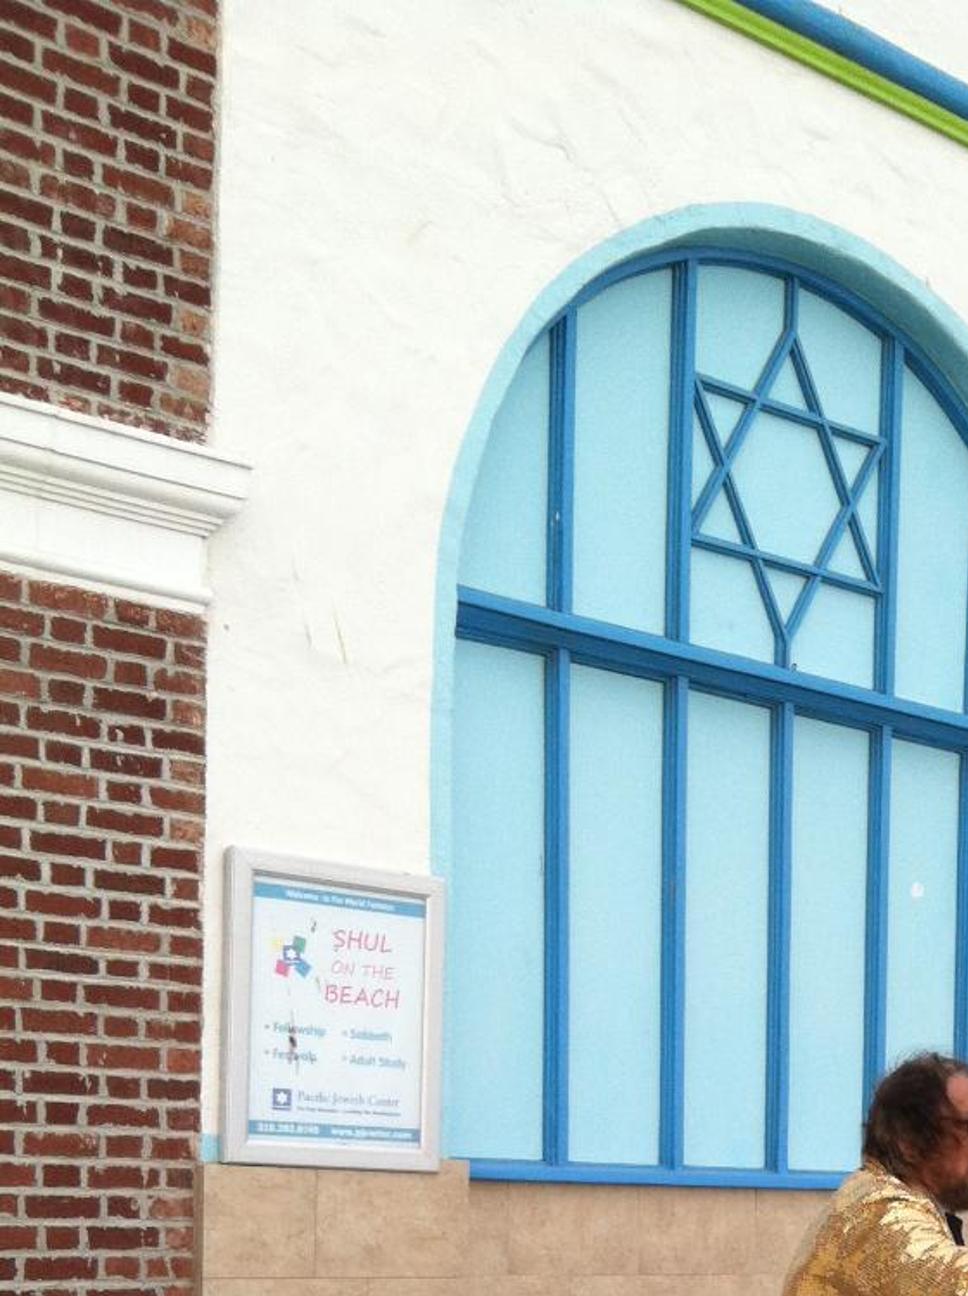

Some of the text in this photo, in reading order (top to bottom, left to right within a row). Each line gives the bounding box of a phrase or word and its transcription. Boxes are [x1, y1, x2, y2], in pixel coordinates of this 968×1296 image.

[333, 929, 392, 953] SHUL
[331, 960, 397, 980] ON THE
[324, 984, 400, 1010] BEACH
